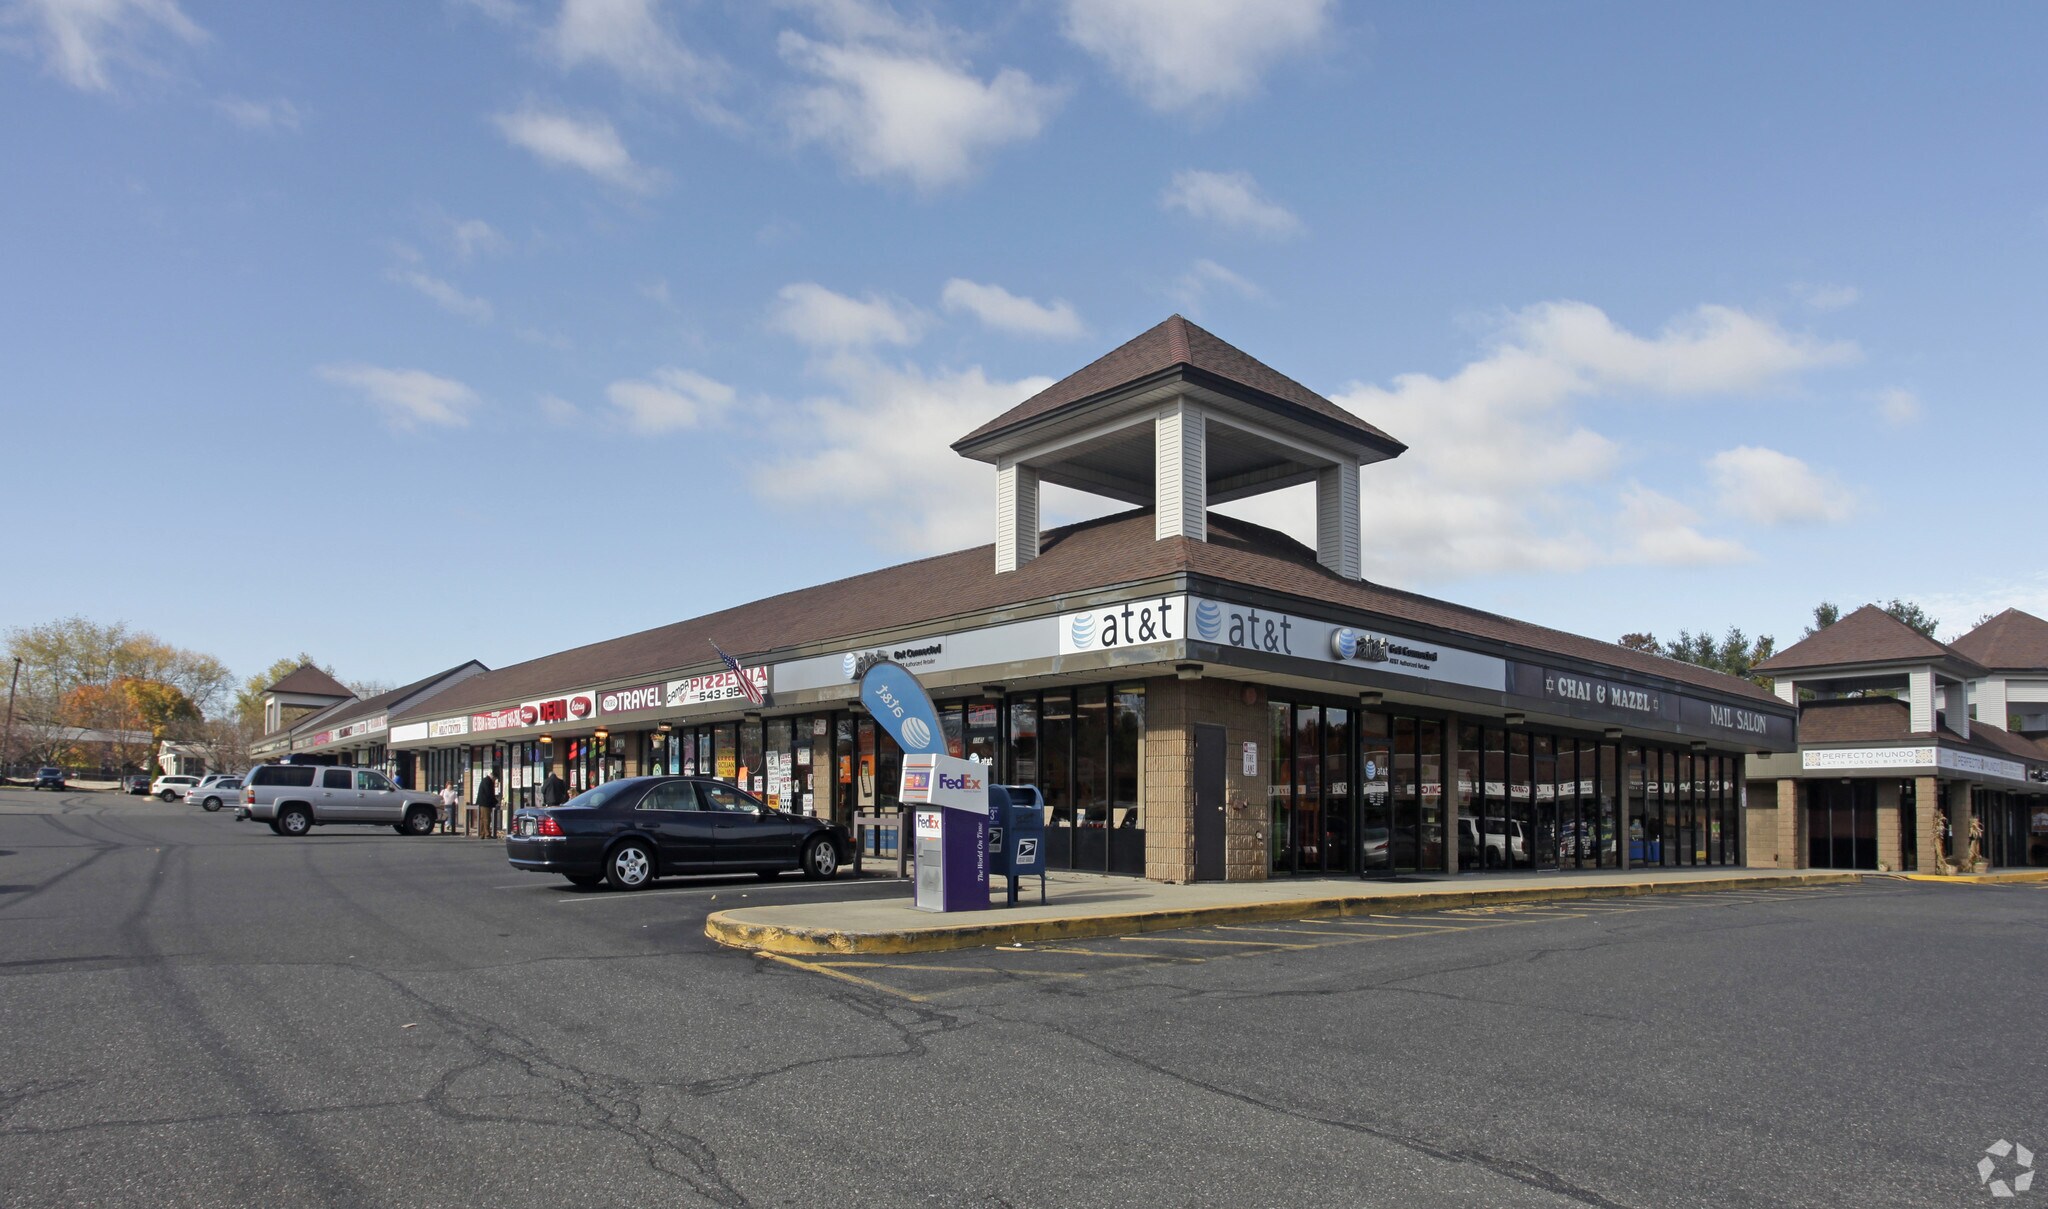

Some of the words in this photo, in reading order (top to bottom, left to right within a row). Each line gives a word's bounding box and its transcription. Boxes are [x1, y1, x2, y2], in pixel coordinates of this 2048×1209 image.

[1101, 597, 1172, 647] at&t
[1228, 608, 1292, 655] at&t
[616, 686, 662, 712] TRAVEL
[1557, 677, 1591, 702] CHAI
[1597, 684, 1606, 704] &
[1611, 687, 1651, 712] MAZEL
[539, 699, 568, 721] DELI
[1710, 704, 1734, 729] NAIL
[1736, 711, 1767, 734] SALON
[1245, 753, 1254, 763] FIRE
[1822, 752, 1874, 760] PERFECTO
[1875, 750, 1914, 758] MUNDO
[1245, 764, 1255, 774] LANE
[939, 773, 981, 790] FedEx
[917, 814, 940, 830] FedEx
[976, 840, 983, 850] On
